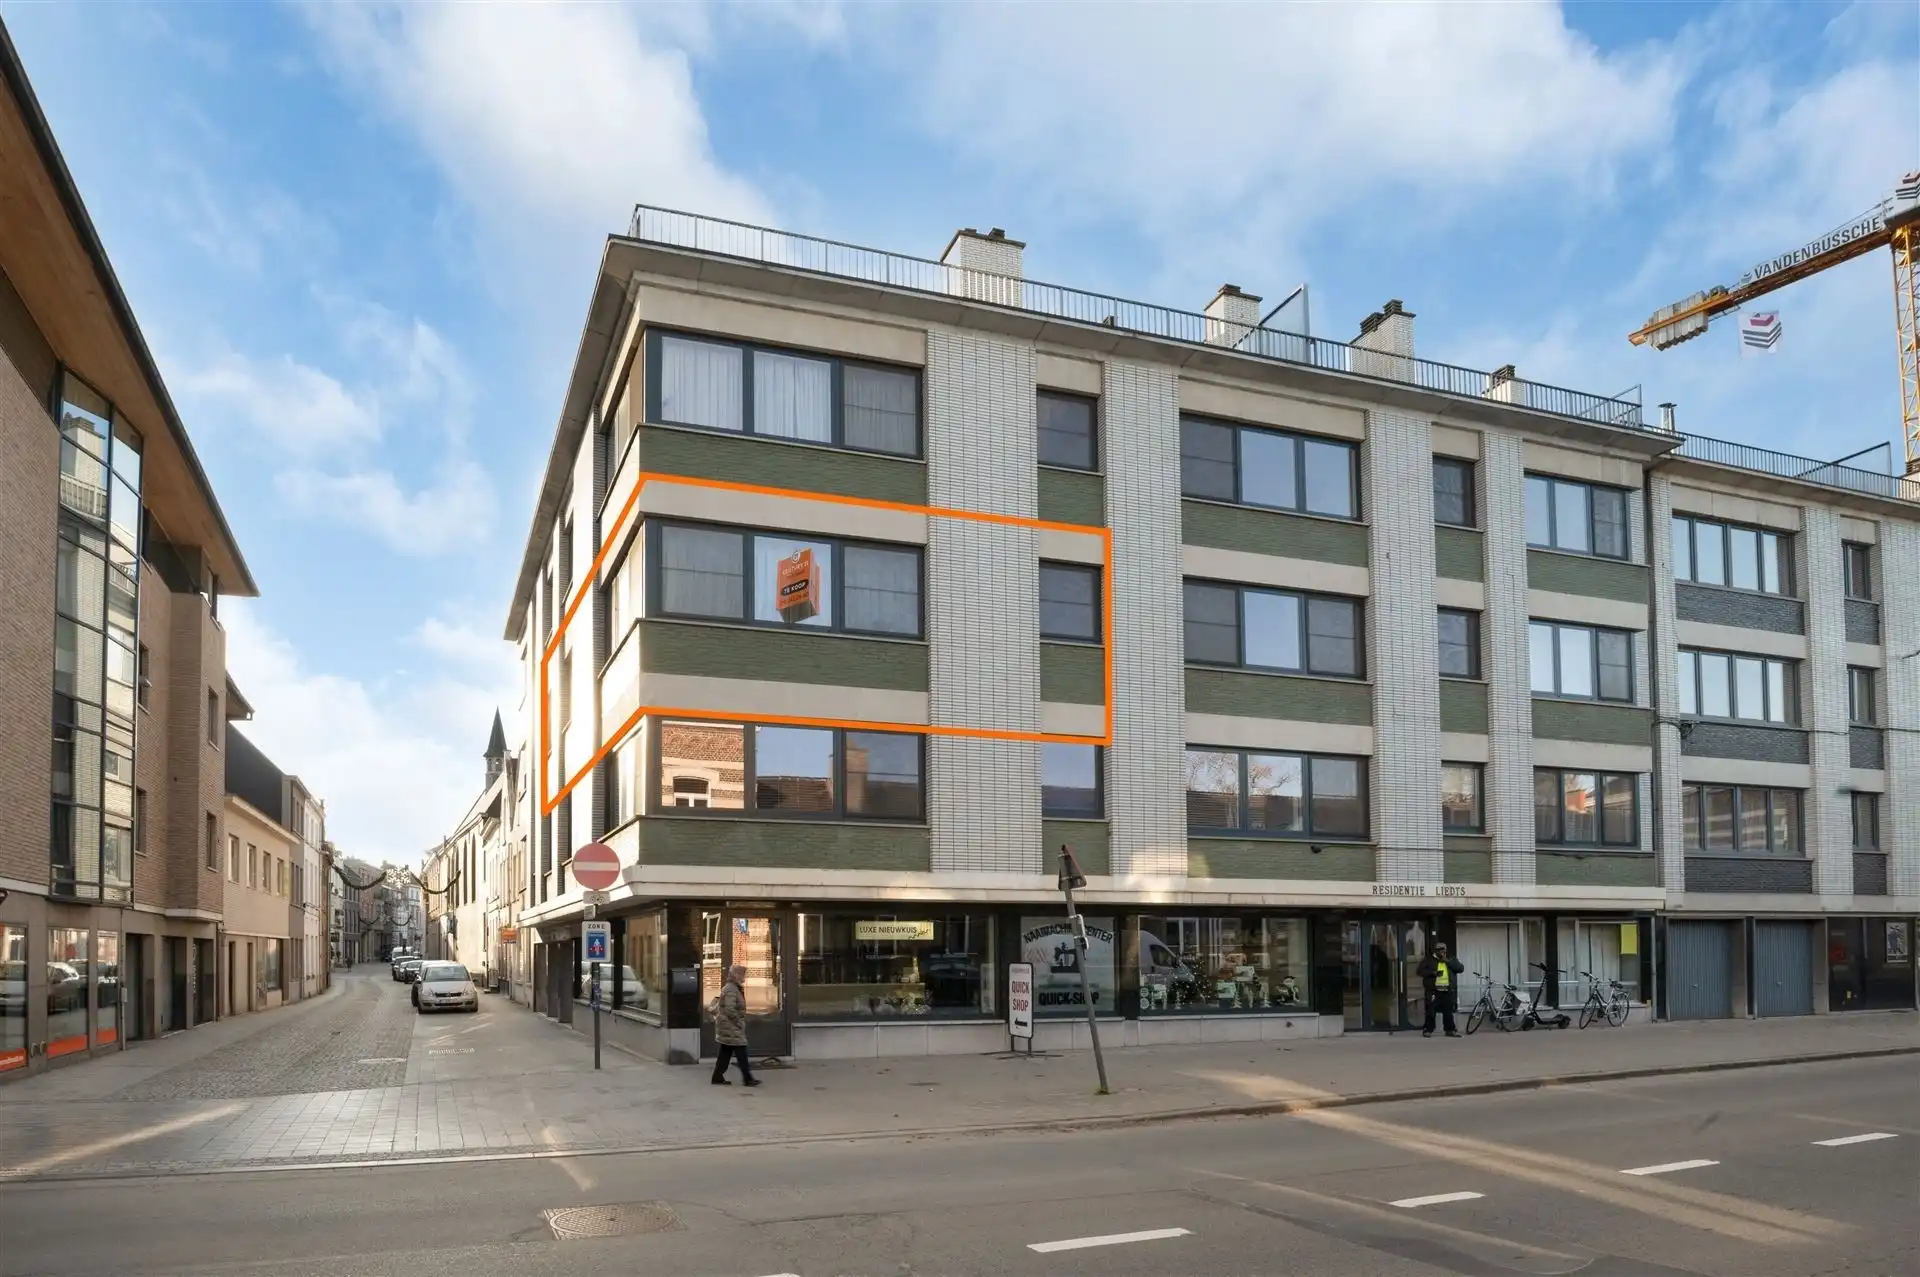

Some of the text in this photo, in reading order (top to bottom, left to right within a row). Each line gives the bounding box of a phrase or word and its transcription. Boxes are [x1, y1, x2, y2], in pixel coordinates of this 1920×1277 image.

[1754, 216, 1880, 279] VANDENBUSSCHE
[791, 581, 806, 591] KOOP
[1372, 885, 1466, 896] RESIDENTIE LIEDTS
[1012, 981, 1029, 994] QUICK
[1012, 999, 1029, 1012] SHOP
